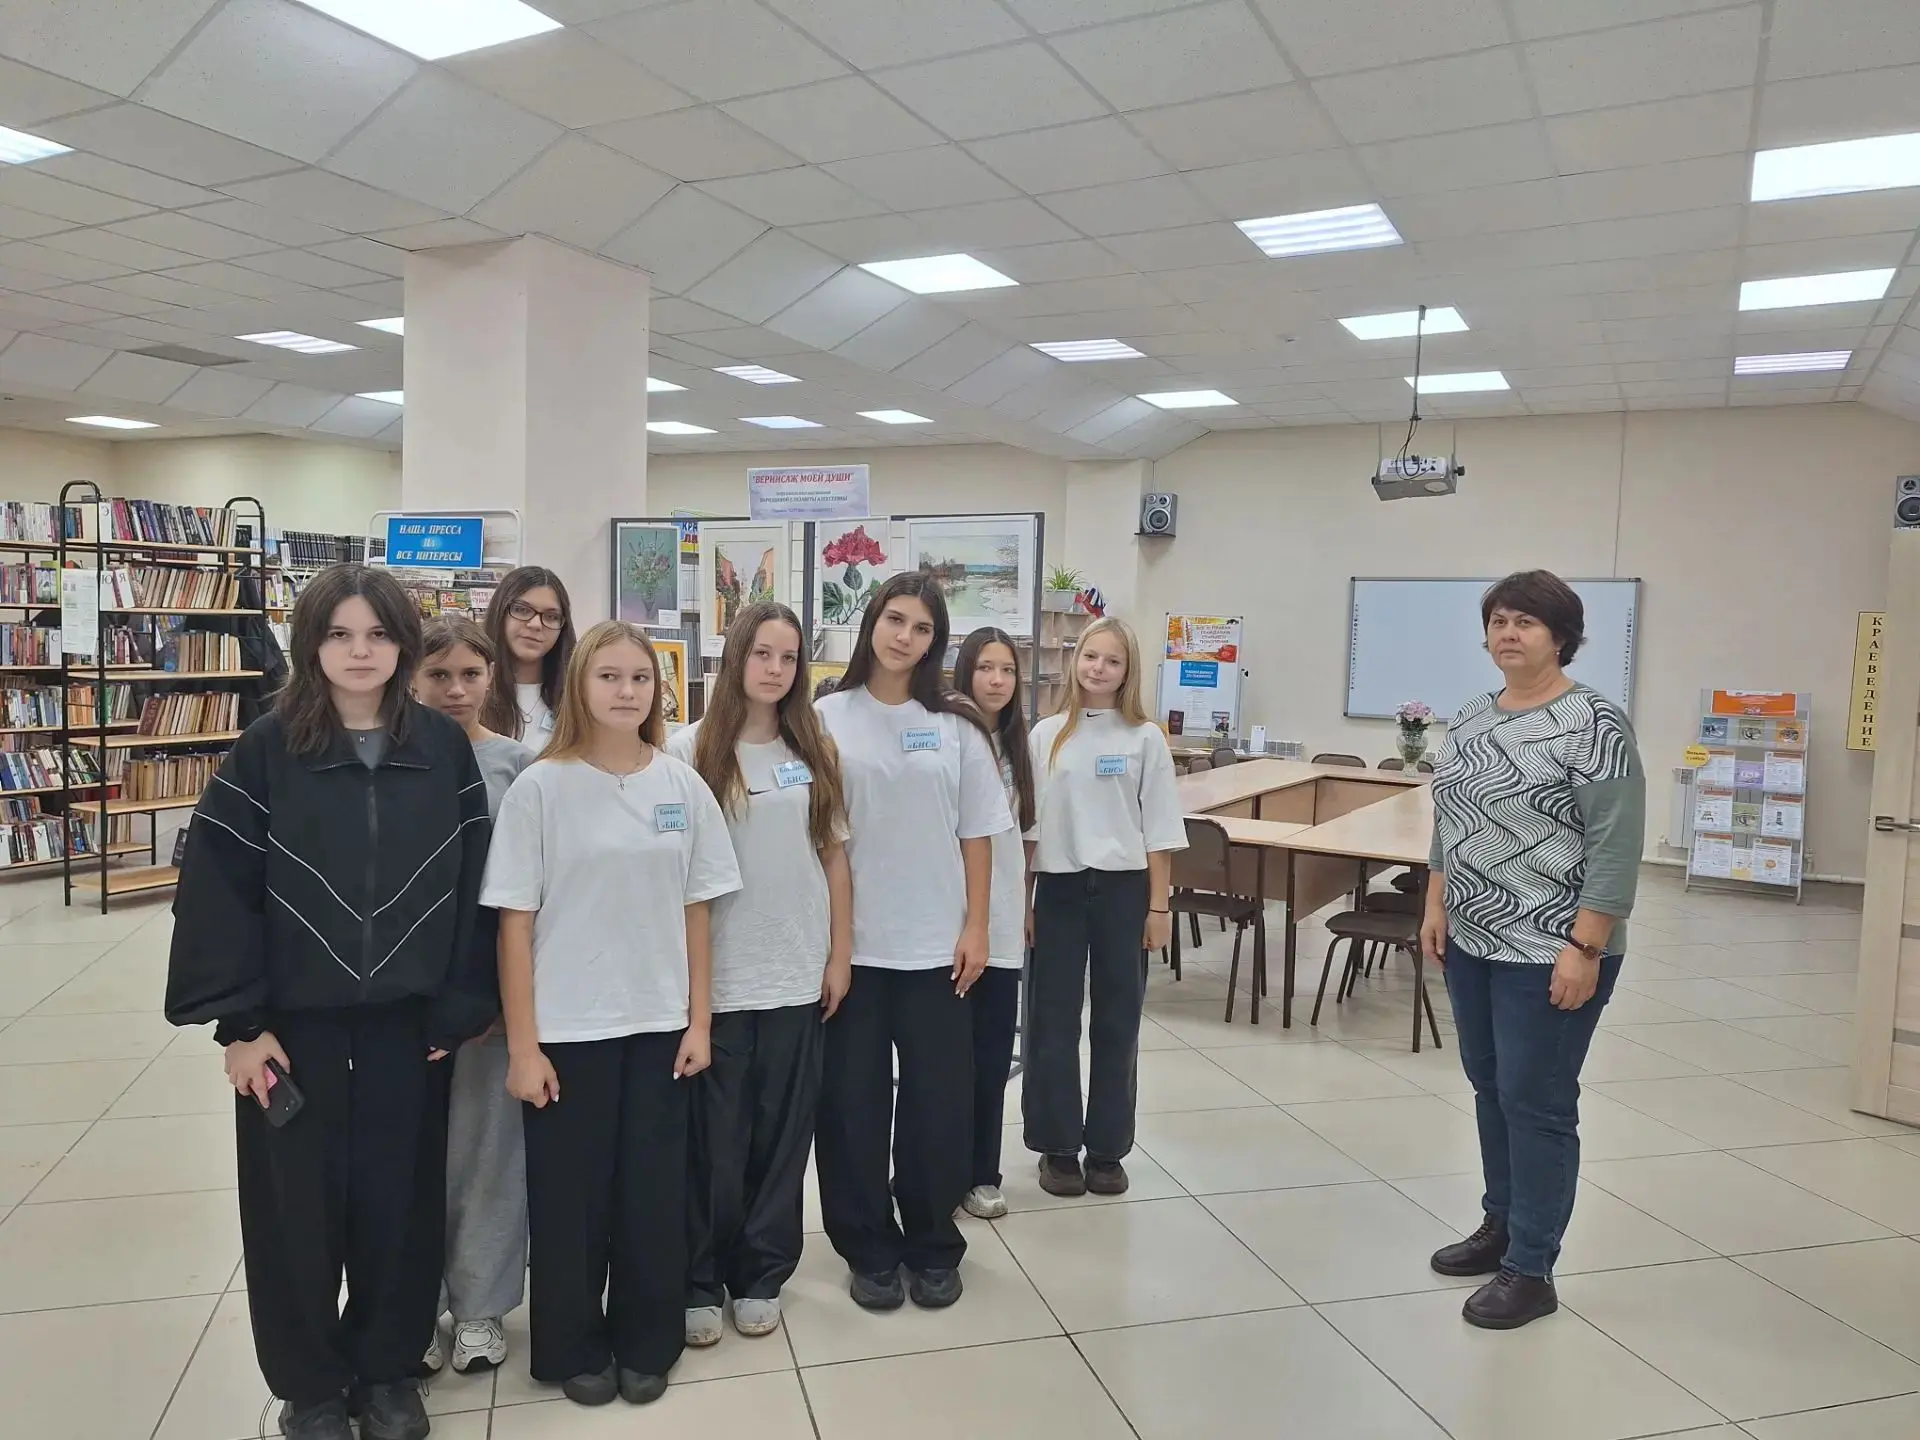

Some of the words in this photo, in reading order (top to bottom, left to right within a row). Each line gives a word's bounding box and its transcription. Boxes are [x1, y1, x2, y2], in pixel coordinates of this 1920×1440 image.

[400, 525, 425, 535] НАША
[428, 525, 461, 535] ПРЕССА
[396, 550, 413, 560] ВСЕ
[416, 551, 463, 562] ИНТЕРЕСЫ
[1861, 616, 1883, 747] КРАЕВЕДЕНИЕ
